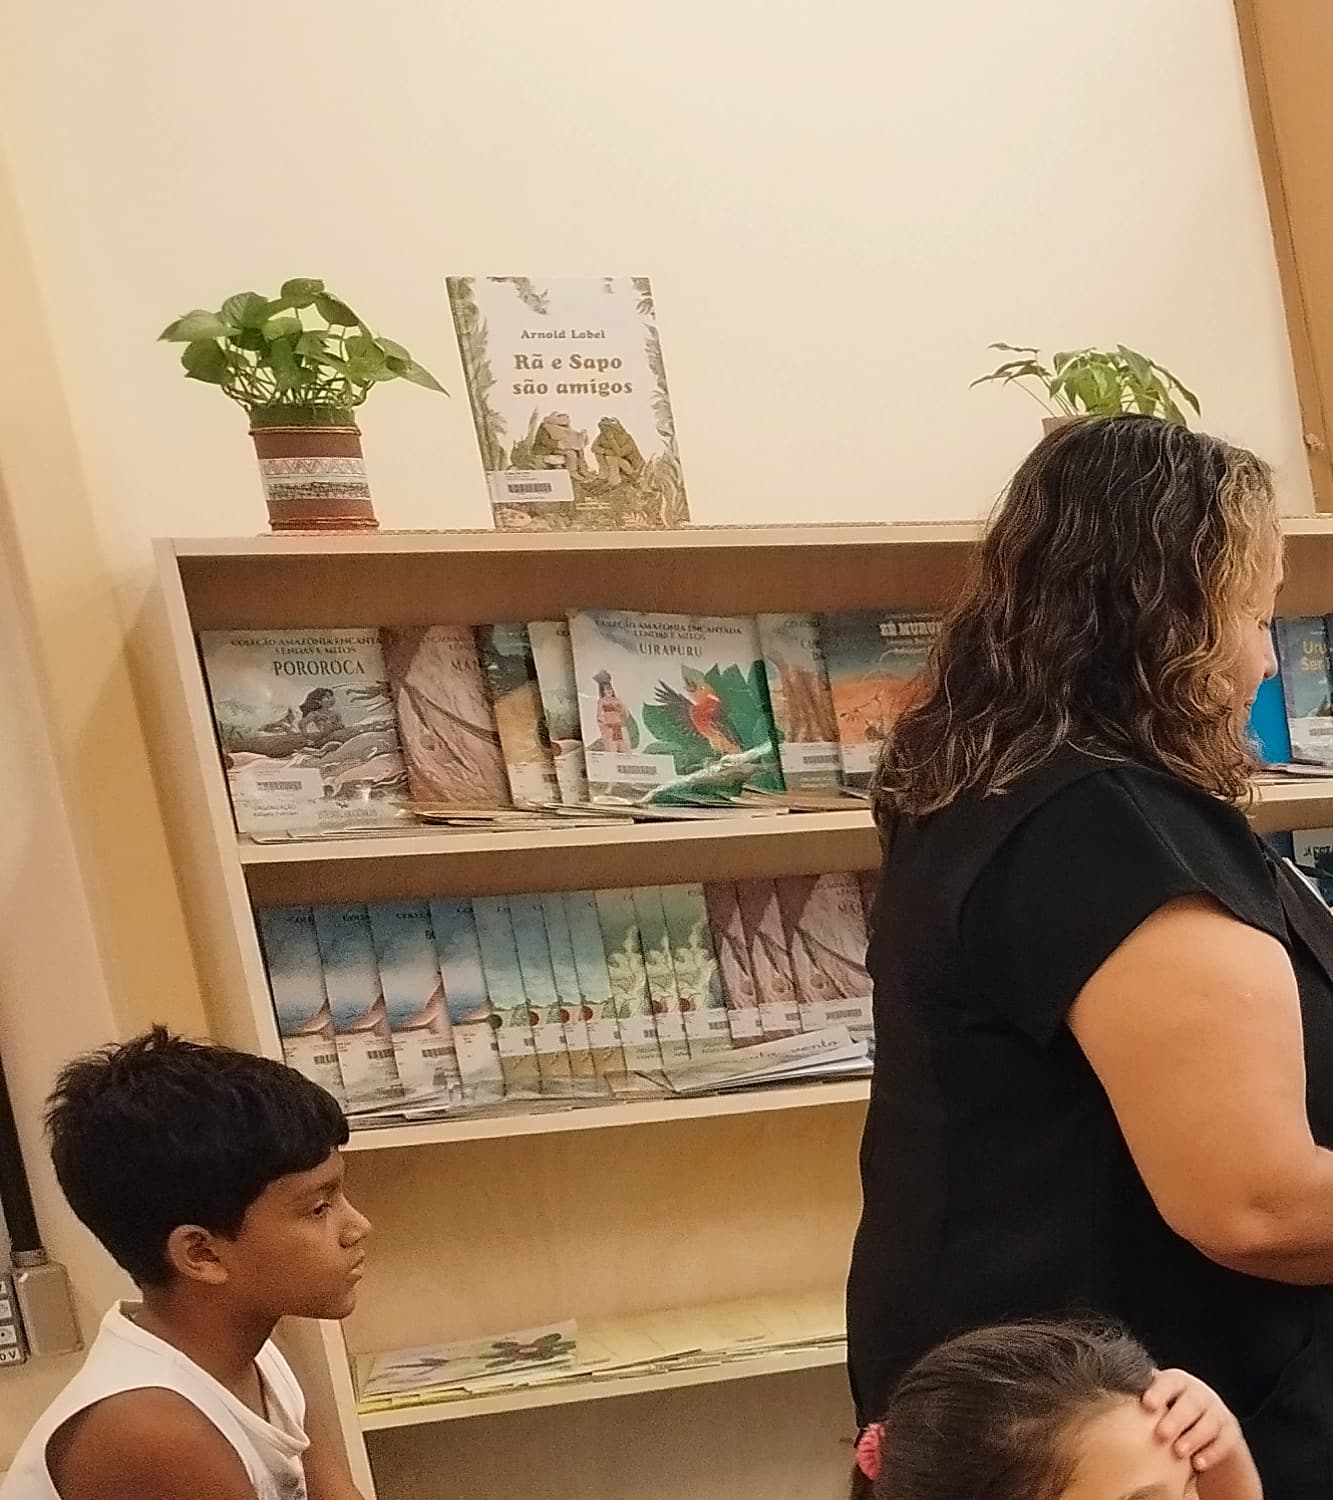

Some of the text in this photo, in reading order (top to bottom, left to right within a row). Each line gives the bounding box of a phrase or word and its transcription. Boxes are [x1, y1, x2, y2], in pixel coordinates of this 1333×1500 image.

[521, 329, 606, 339] Arnold Lobel
[514, 354, 622, 372] Rã e Sapo
[512, 379, 633, 397] são amigos
[639, 642, 702, 657] UIRAPURU
[273, 660, 365, 677] POROROCA
